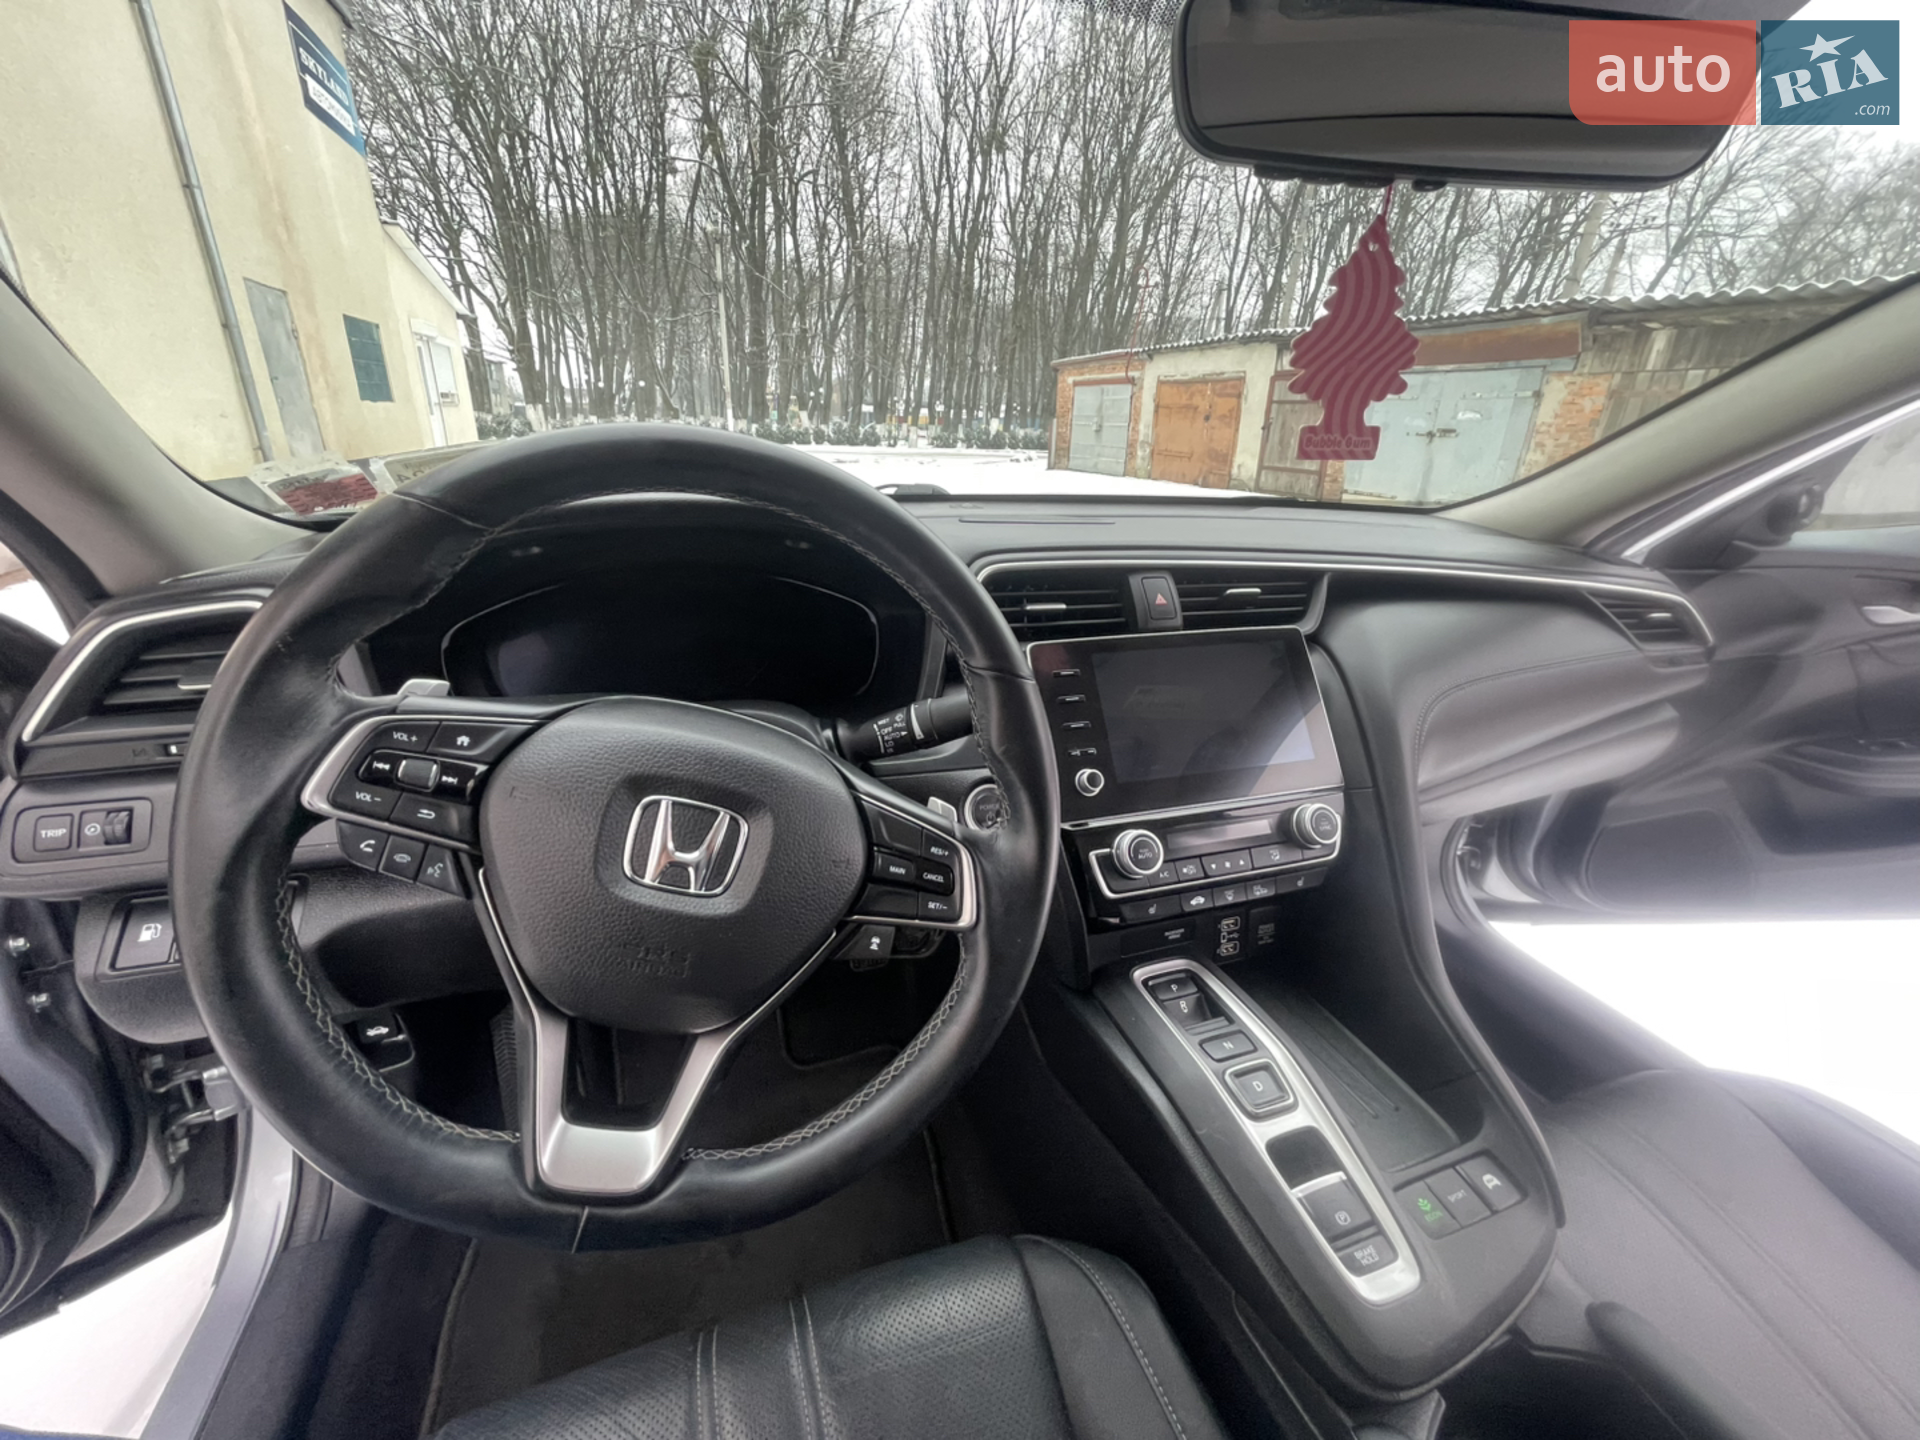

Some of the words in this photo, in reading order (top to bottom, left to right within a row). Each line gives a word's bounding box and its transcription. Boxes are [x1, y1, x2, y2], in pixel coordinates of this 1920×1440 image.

[299, 46, 350, 107] SKYLAND
[1304, 434, 1342, 449] Bubble
[1344, 435, 1371, 449] Gum
[40, 827, 67, 838] TRIP
[889, 864, 906, 875] MAIN
[922, 871, 945, 883] CANCEL
[1171, 983, 1178, 993] P
[1222, 1041, 1234, 1050] N
[1252, 1080, 1263, 1092] D
[1447, 1188, 1468, 1204] SPORT
[1354, 1245, 1377, 1260] BRAKE
[1360, 1252, 1380, 1267] HOLD
